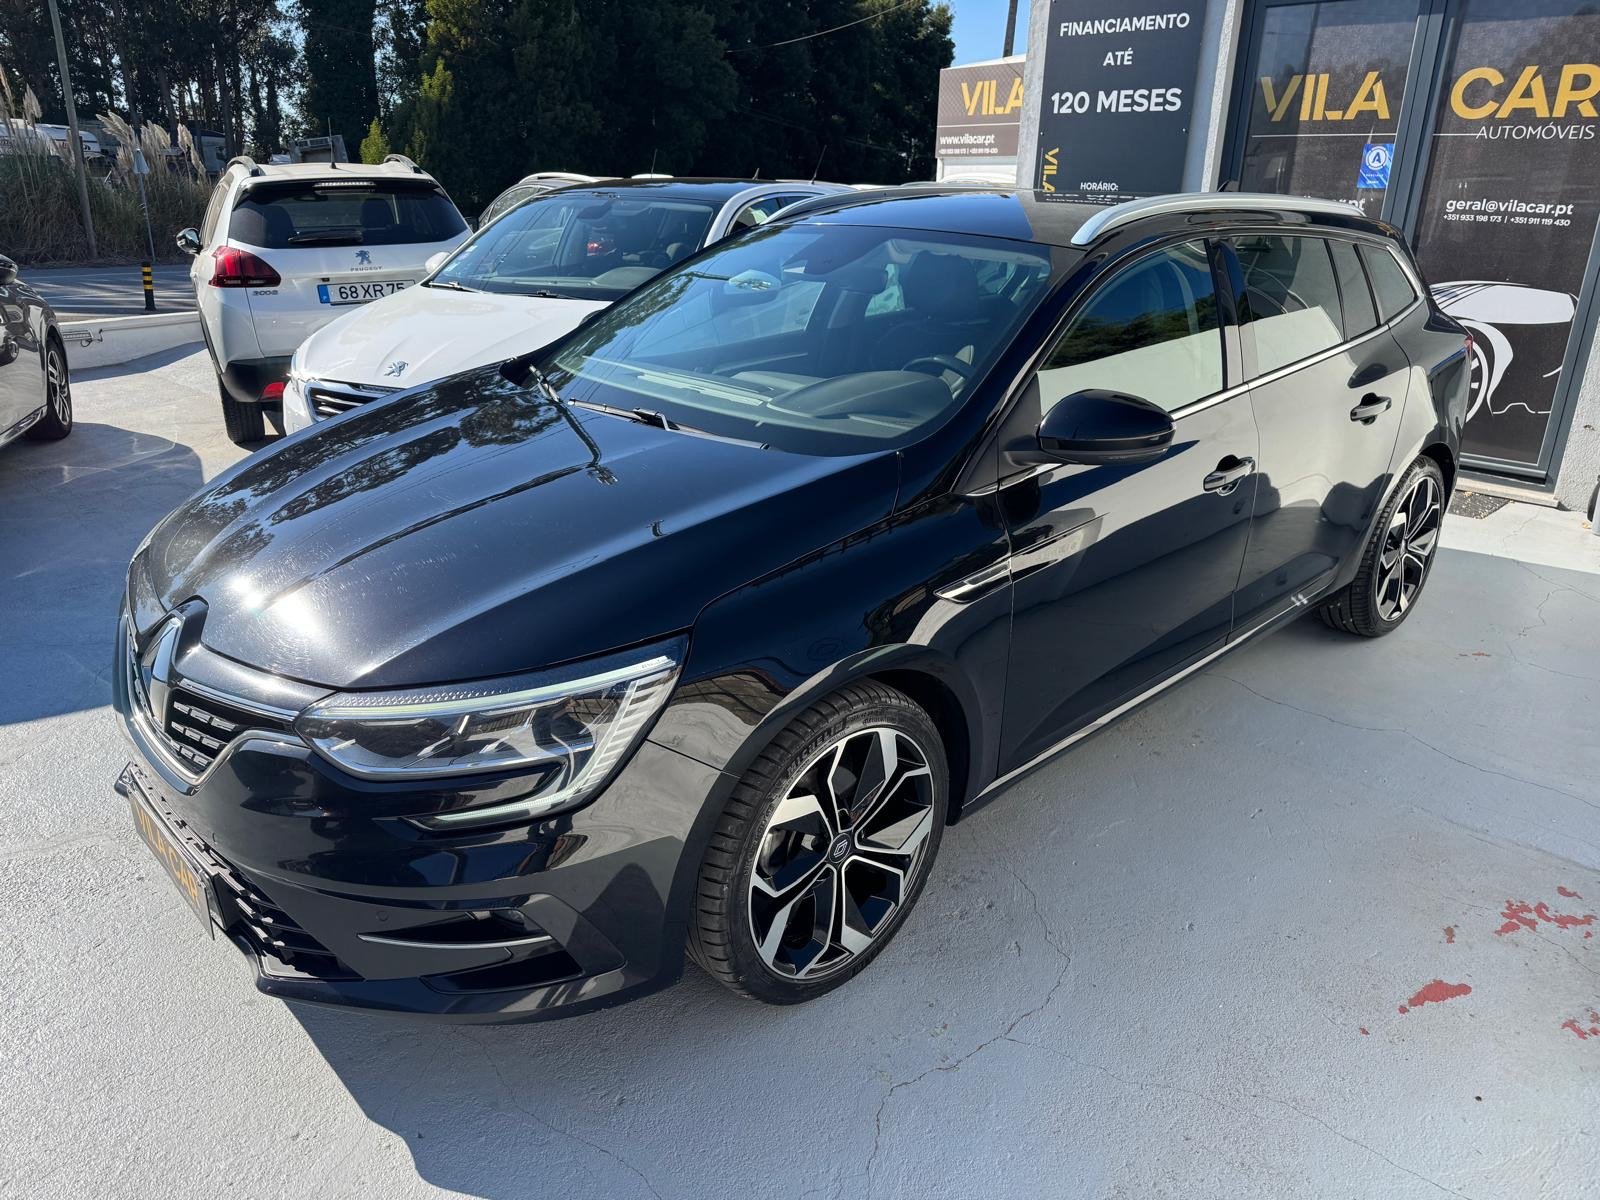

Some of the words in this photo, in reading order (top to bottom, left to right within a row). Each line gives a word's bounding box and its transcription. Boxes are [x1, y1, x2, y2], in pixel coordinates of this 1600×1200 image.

[1060, 12, 1190, 36] FINANCIAMENTO
[1103, 48, 1133, 66] ATÉ
[961, 77, 1024, 116] VILA
[1051, 91, 1090, 114] 120
[1096, 88, 1182, 113] MESES
[1260, 71, 1390, 122] VILA
[1451, 63, 1600, 120] CAR
[940, 133, 995, 146] www.vilacar.pt
[1476, 121, 1596, 140] AUTOMÓVEIS
[1080, 181, 1119, 191] HORÁRIO:
[1446, 198, 1574, 217] geral@vilacar.pt
[1554, 219, 1571, 227] 430
[338, 286, 359, 300] 68
[360, 283, 385, 298] XR
